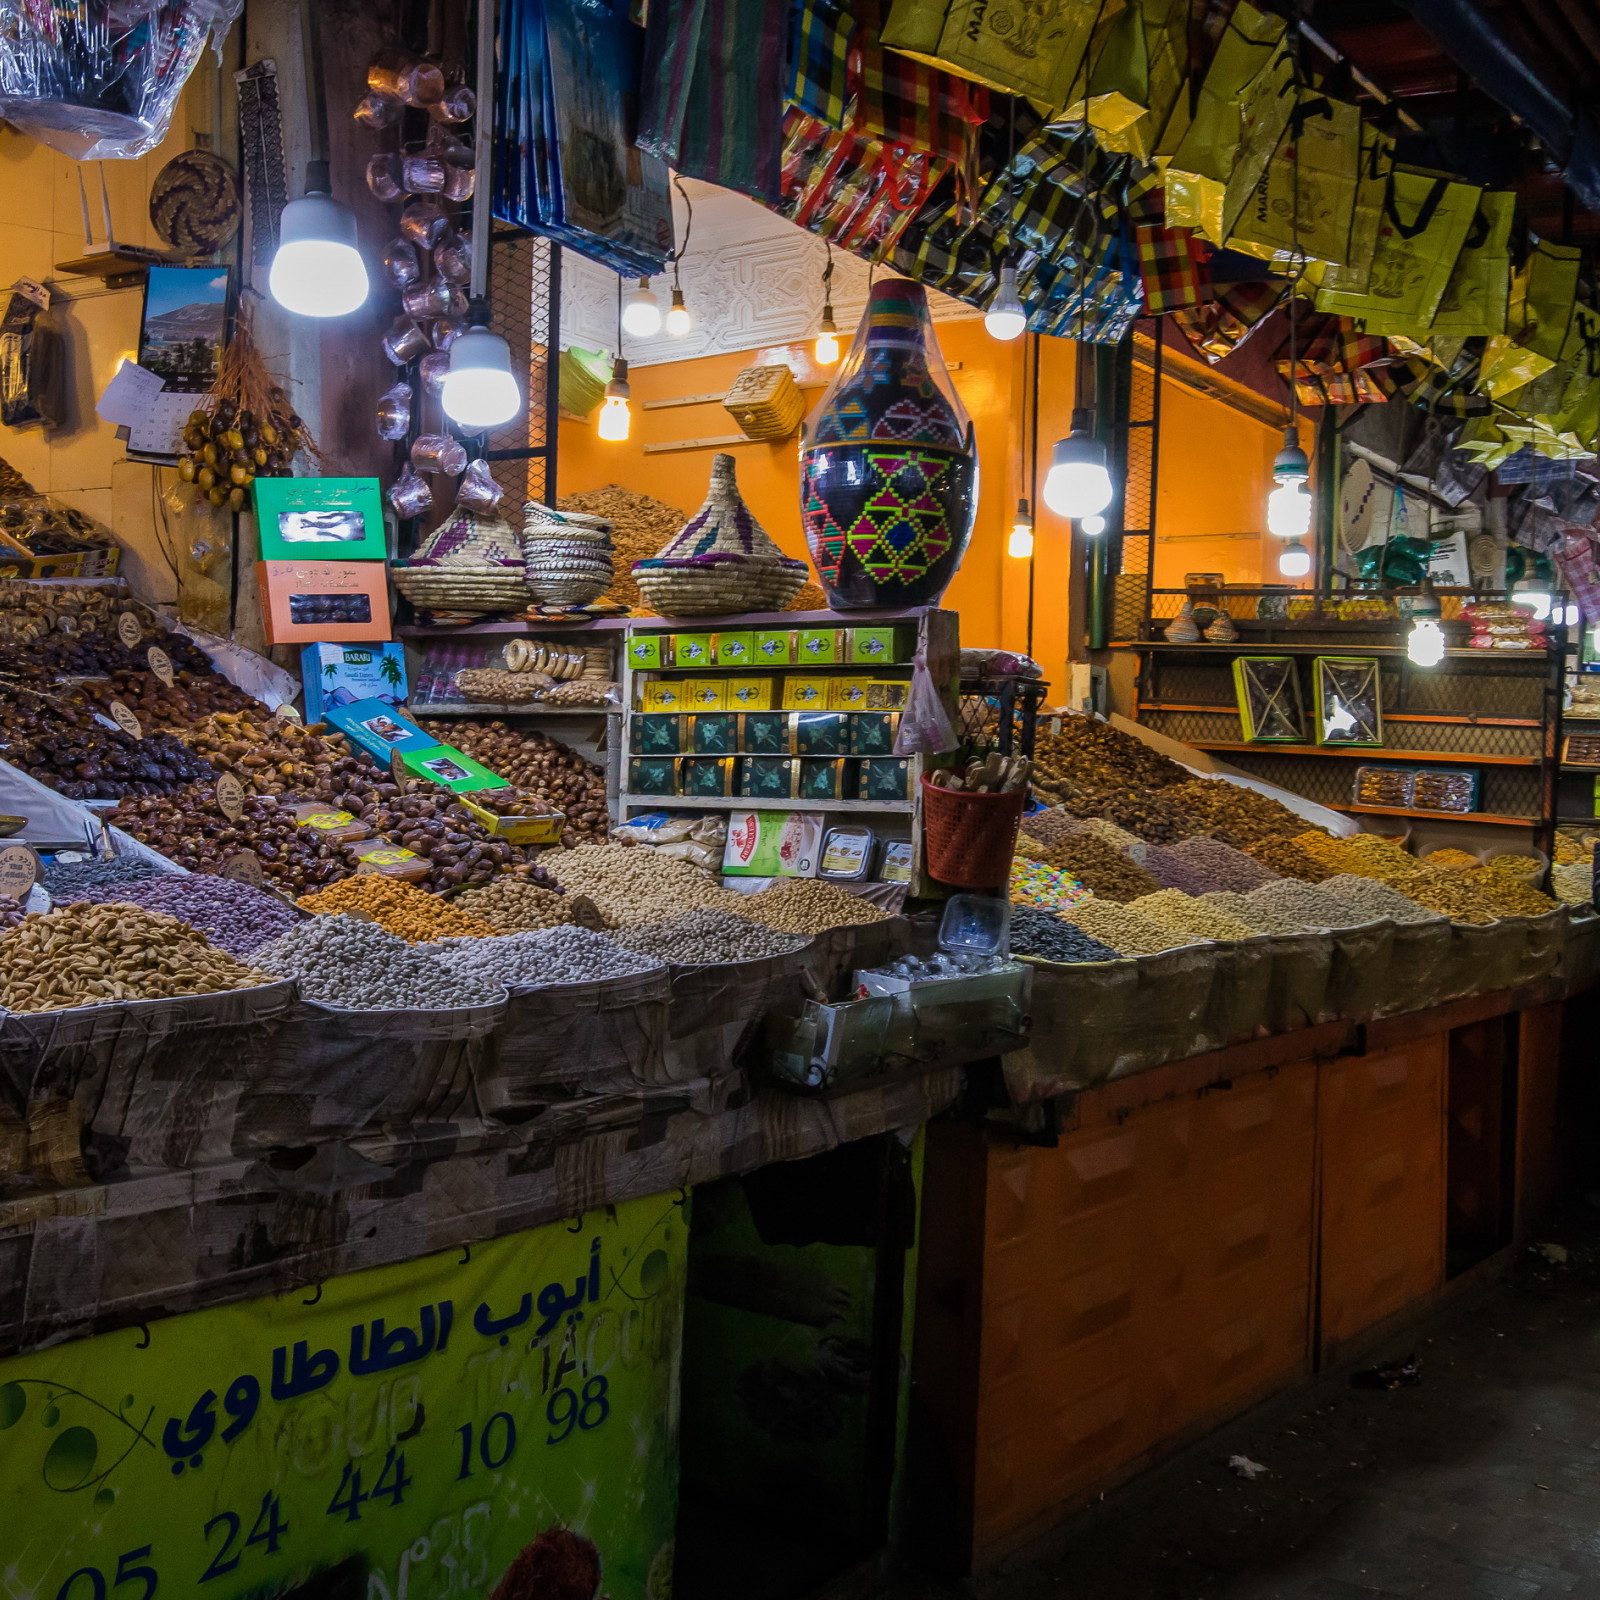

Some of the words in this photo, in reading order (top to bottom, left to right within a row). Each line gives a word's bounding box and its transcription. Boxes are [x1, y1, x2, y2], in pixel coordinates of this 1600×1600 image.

[344, 652, 371, 662] BARARI
[473, 1237, 601, 1347] أيوب
[162, 1300, 454, 1476] الطاطاوي
[57, 1544, 158, 1600] 05
[199, 1488, 290, 1584] 24
[328, 1448, 412, 1522] 44
[454, 1412, 516, 1480] 10
[546, 1375, 610, 1447] 98
